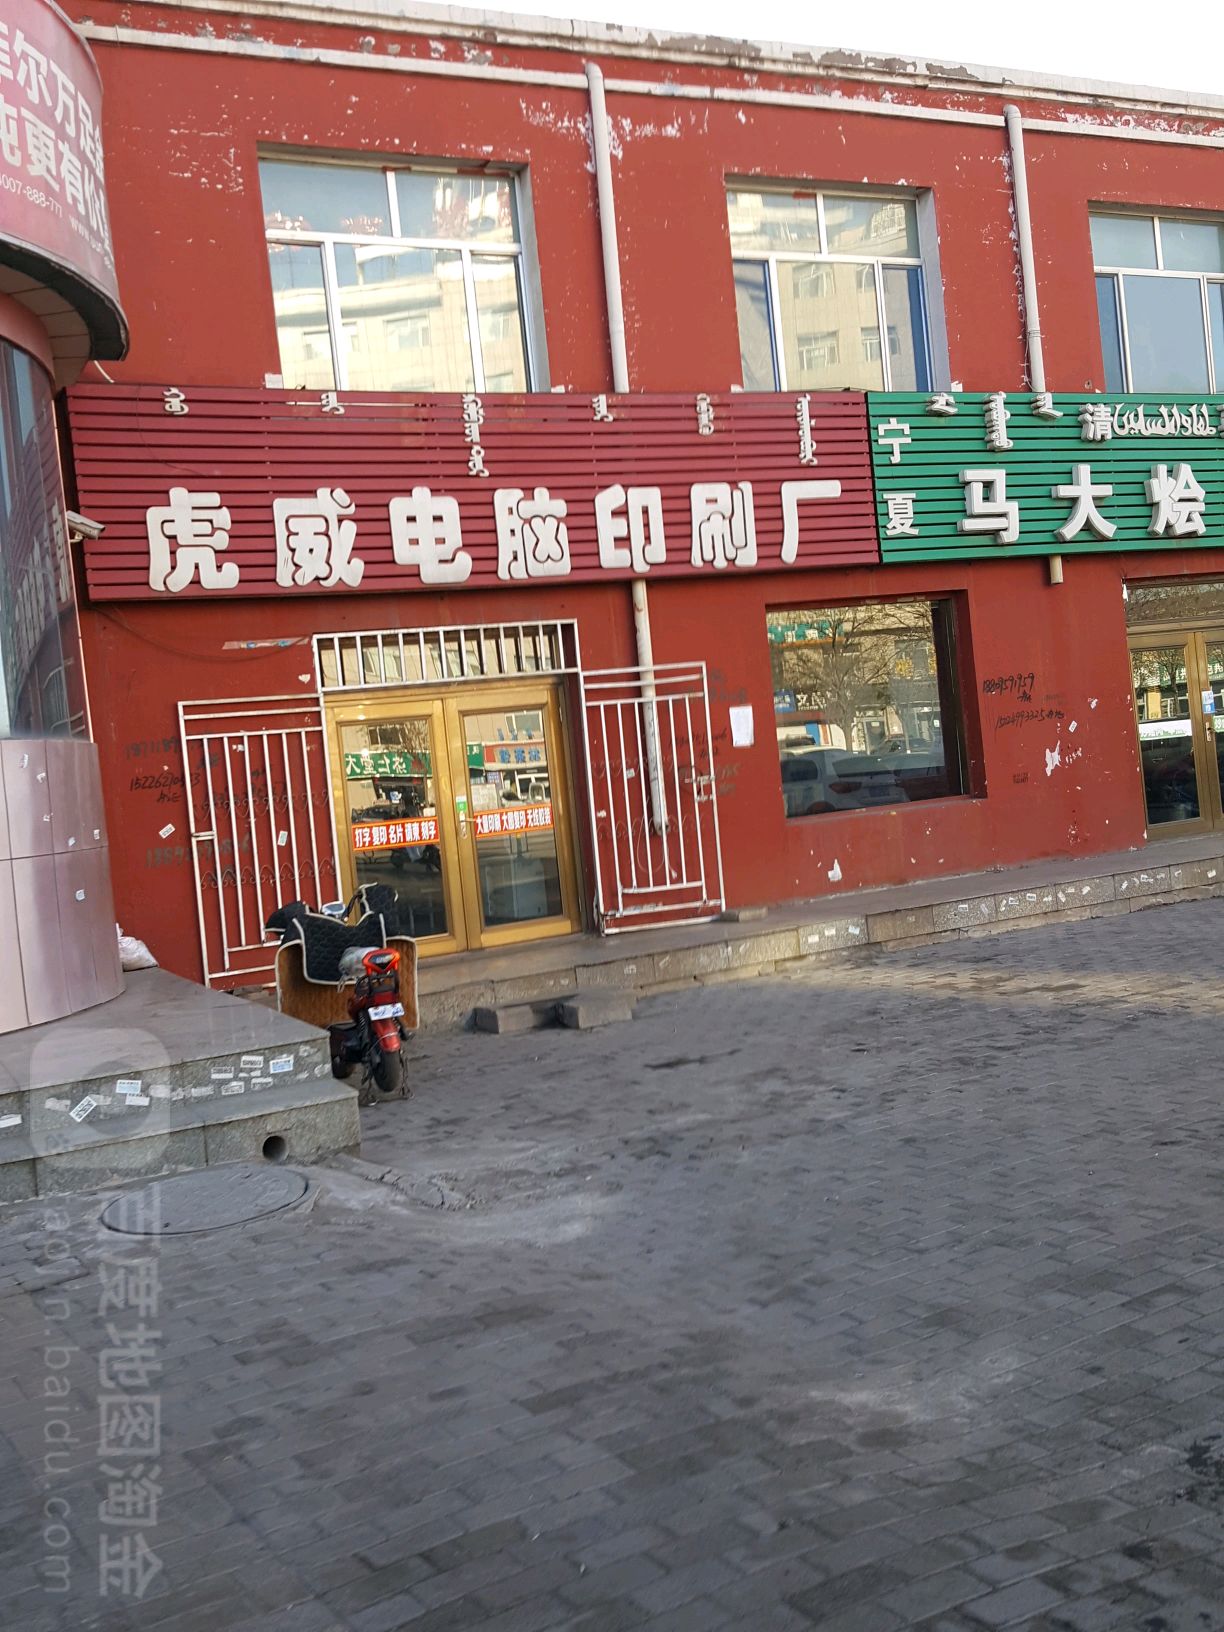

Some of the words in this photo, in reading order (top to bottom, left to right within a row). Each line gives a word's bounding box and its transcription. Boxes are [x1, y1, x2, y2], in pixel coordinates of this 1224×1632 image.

[1078, 403, 1113, 442] 清
[957, 462, 1207, 545] 马大烩
[145, 479, 843, 594] 虎威电脑印刷厂
[355, 827, 371, 848] 打字
[372, 825, 388, 846] 复印
[389, 823, 404, 844] 名片
